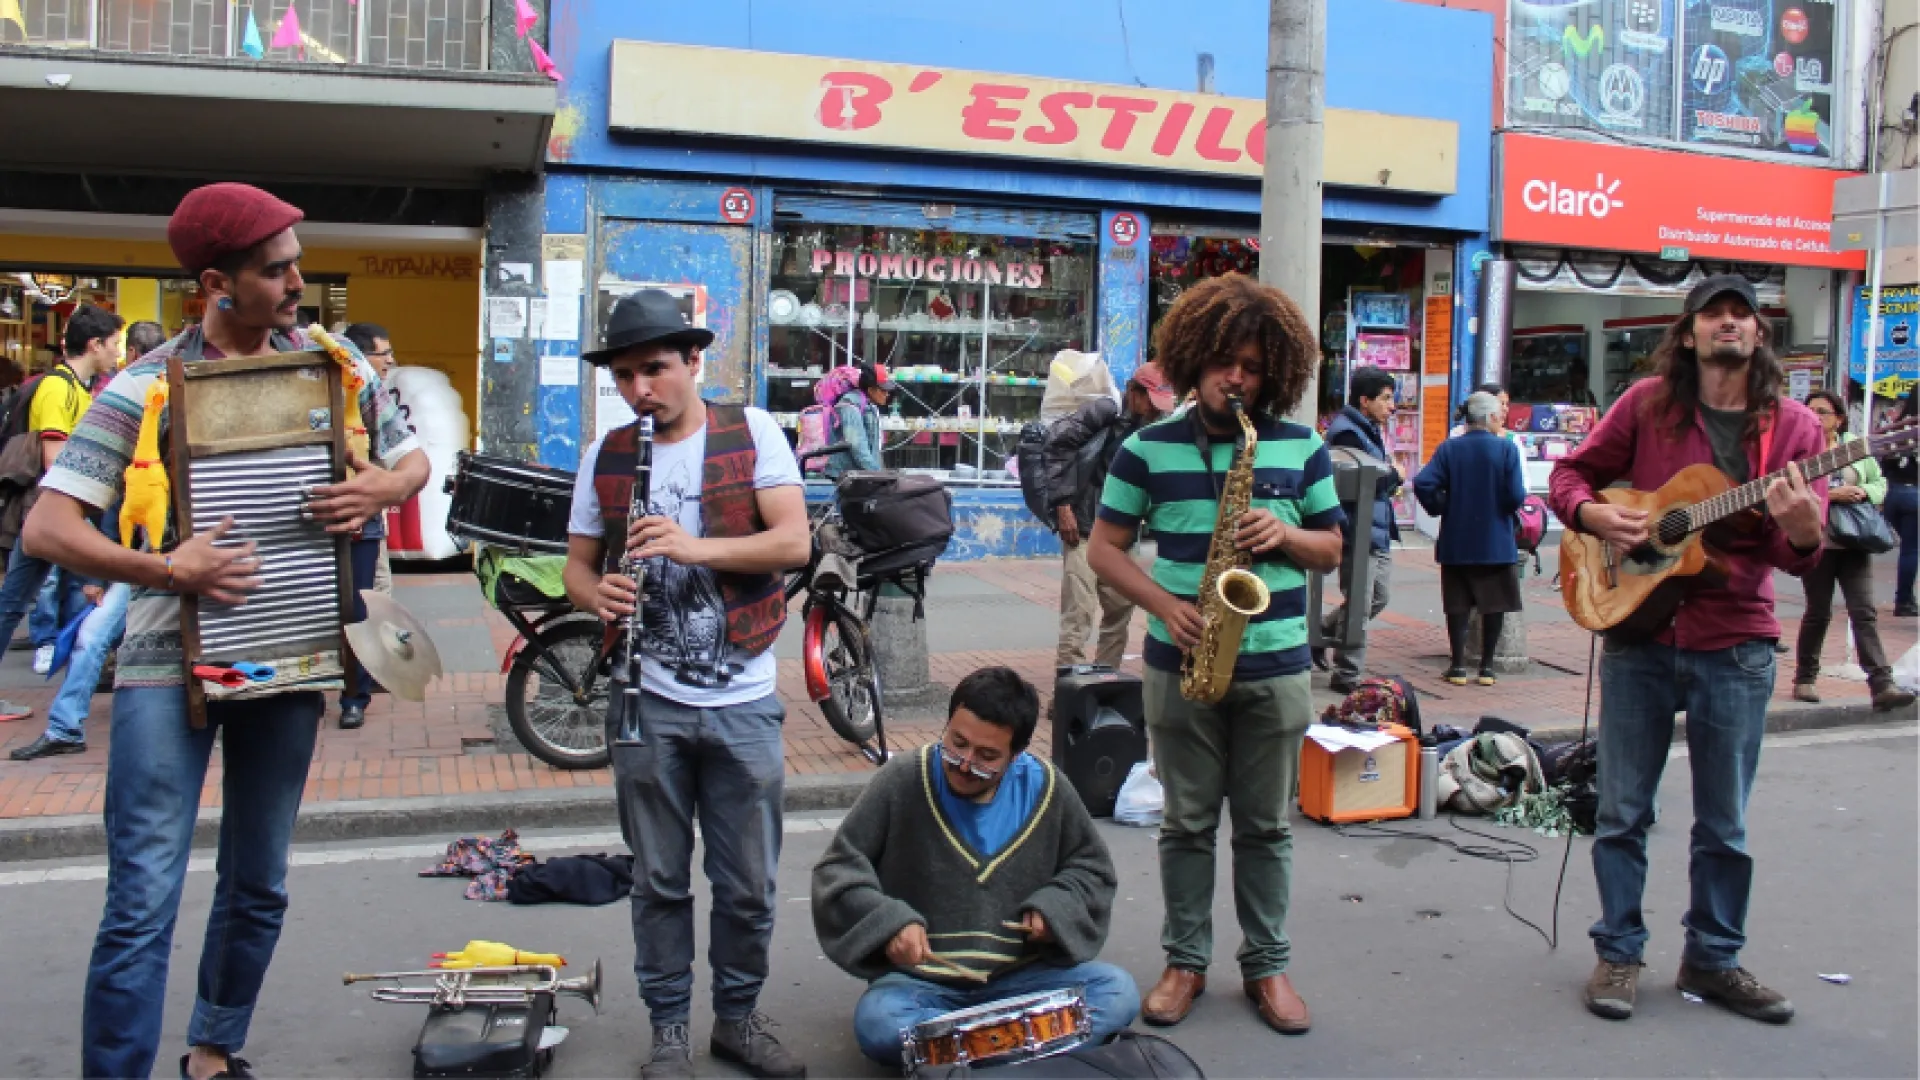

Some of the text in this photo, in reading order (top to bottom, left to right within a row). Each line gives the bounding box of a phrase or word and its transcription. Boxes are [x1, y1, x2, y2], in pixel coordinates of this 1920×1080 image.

[1693, 45, 1725, 94] hp
[1796, 57, 1821, 81] LG
[1696, 110, 1760, 131] TOSHIBA
[1522, 179, 1610, 218] Claro
[1696, 207, 1773, 226] Supermercado
[1659, 225, 1721, 244] Distribuidor
